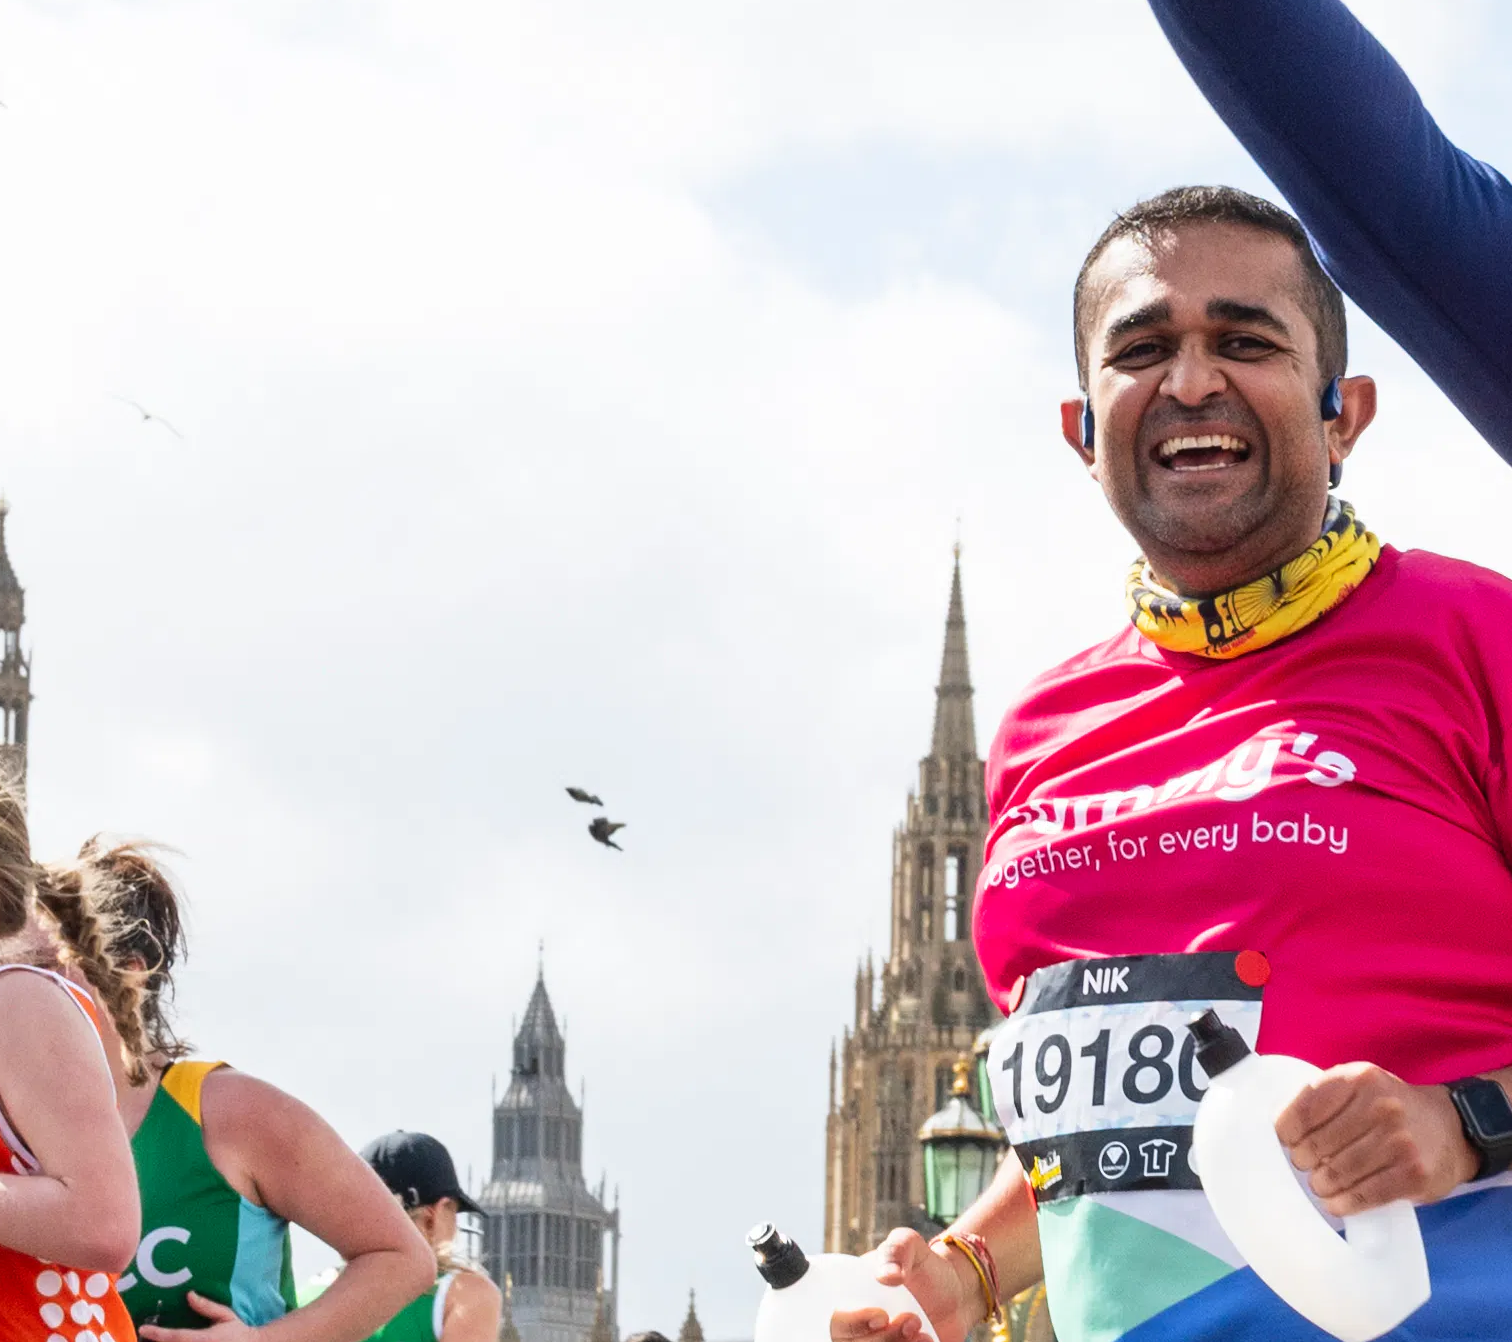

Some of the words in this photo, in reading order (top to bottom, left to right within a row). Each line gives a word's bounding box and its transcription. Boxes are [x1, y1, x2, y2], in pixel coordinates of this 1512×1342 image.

[1108, 830, 1149, 862] for
[1159, 820, 1239, 855] every
[1252, 811, 1349, 854] baby
[1082, 966, 1130, 995] NIK
